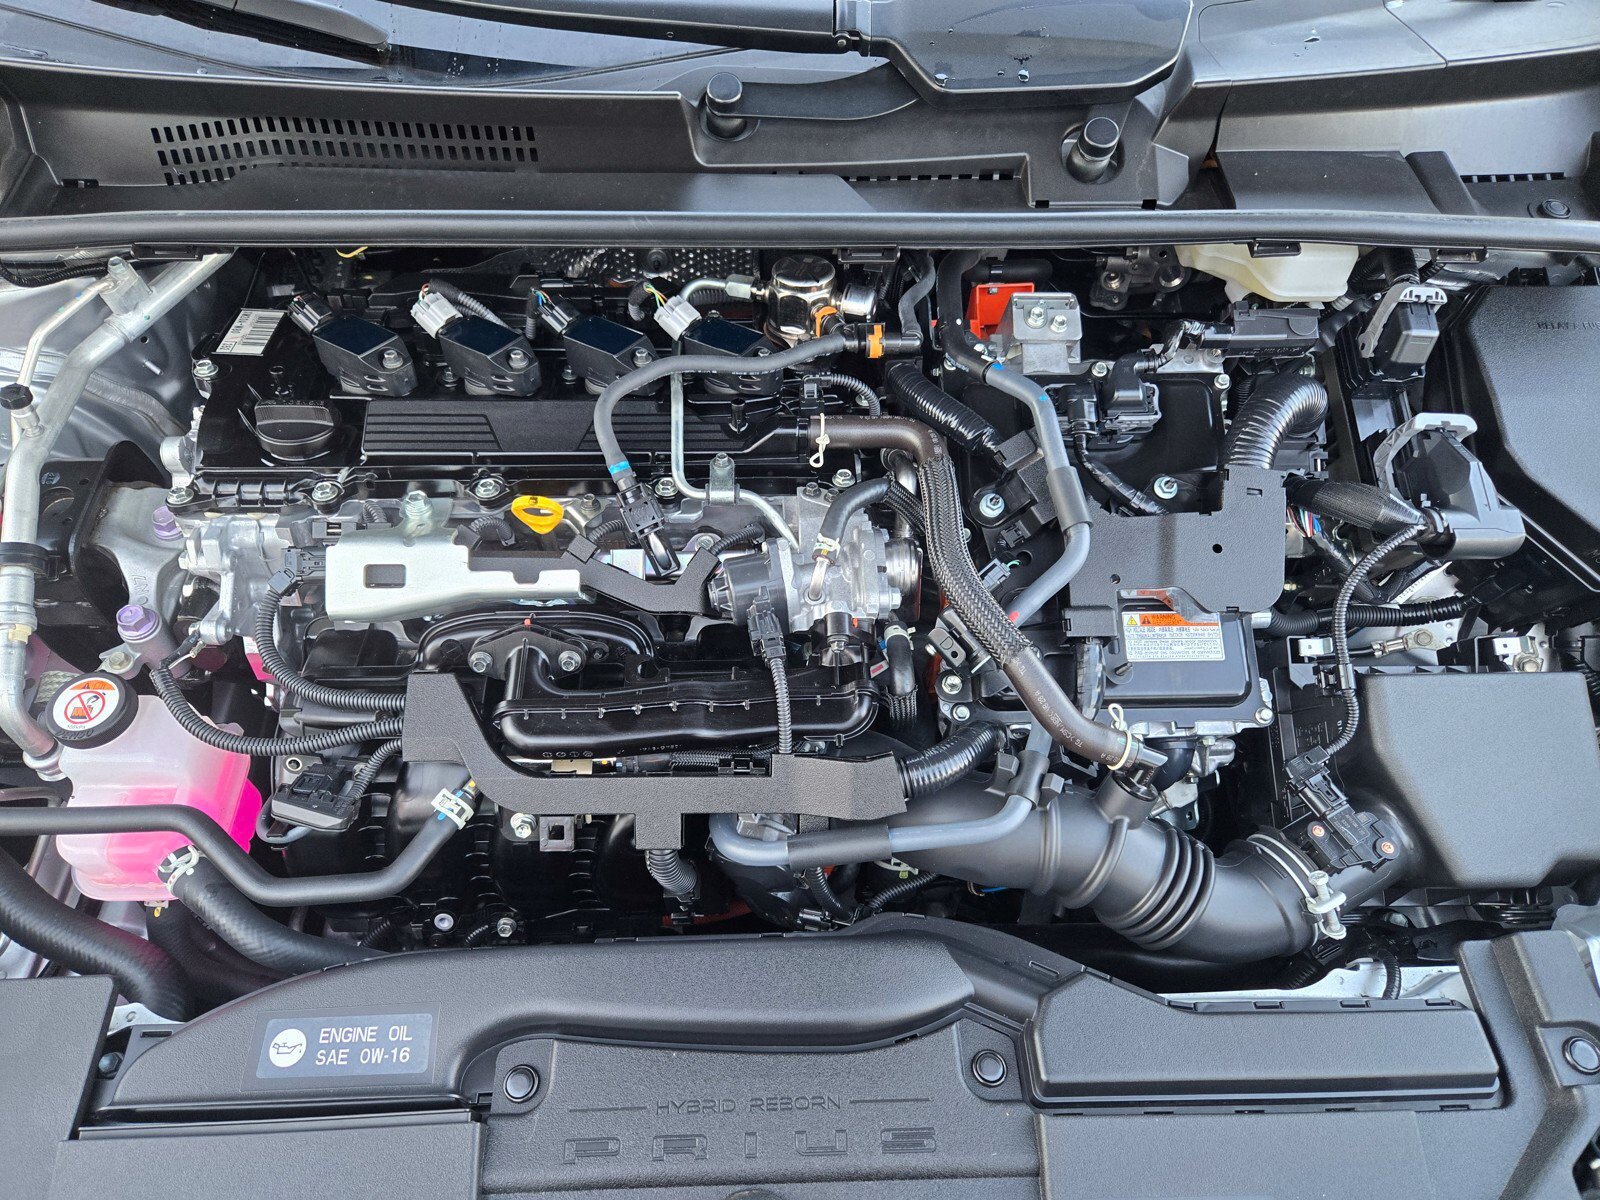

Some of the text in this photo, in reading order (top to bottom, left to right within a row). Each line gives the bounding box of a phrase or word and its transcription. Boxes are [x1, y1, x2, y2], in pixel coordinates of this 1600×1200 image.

[319, 1025, 413, 1044] ENGINE OIL
[315, 1047, 410, 1066] SAE 0W-16
[655, 1095, 842, 1116] HYBRID REBORN
[563, 1126, 938, 1165] PRIUS
